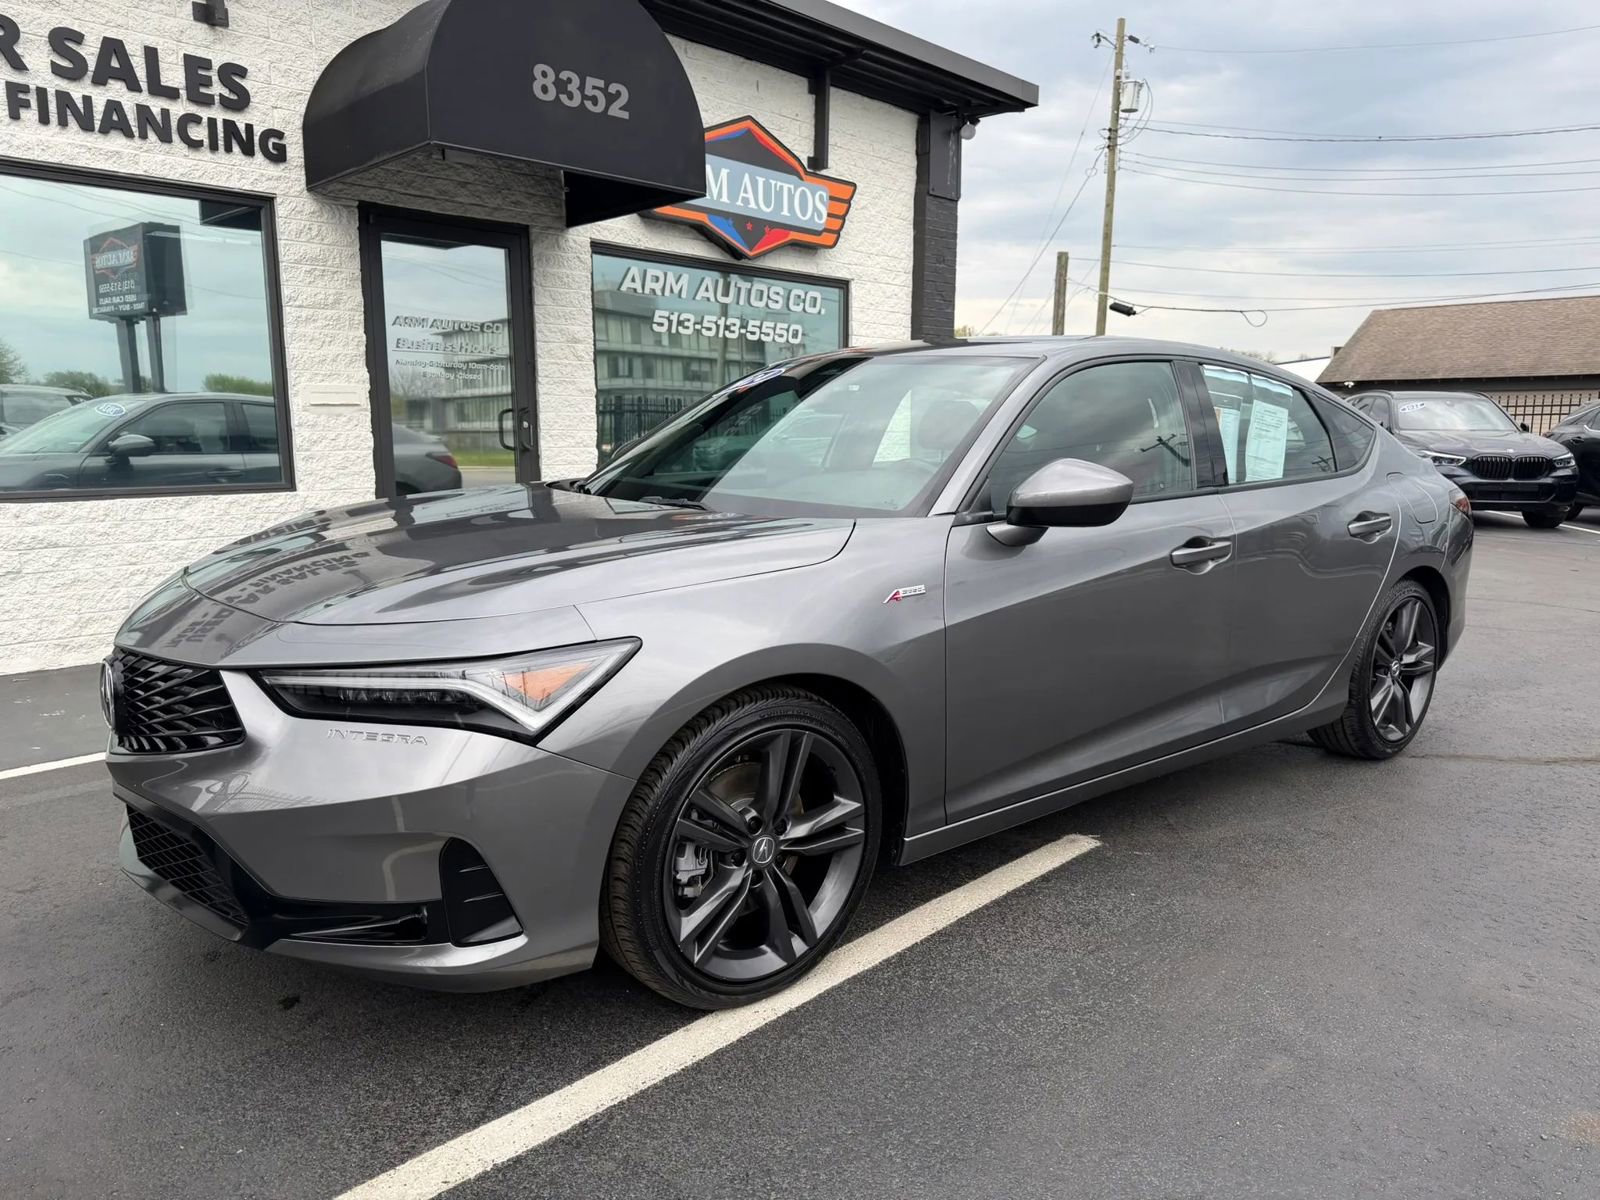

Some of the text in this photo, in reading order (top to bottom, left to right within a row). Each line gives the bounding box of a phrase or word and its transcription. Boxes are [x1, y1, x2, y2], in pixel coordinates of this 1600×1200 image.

[48, 26, 251, 111] SALES
[532, 63, 630, 120] 8352
[5, 81, 287, 163] FINANCING
[735, 172, 828, 224] AUTOS
[619, 266, 826, 315] ARM AUTOS CO.
[652, 309, 803, 344] 513-513-5550
[327, 728, 429, 746] INTEGRA
